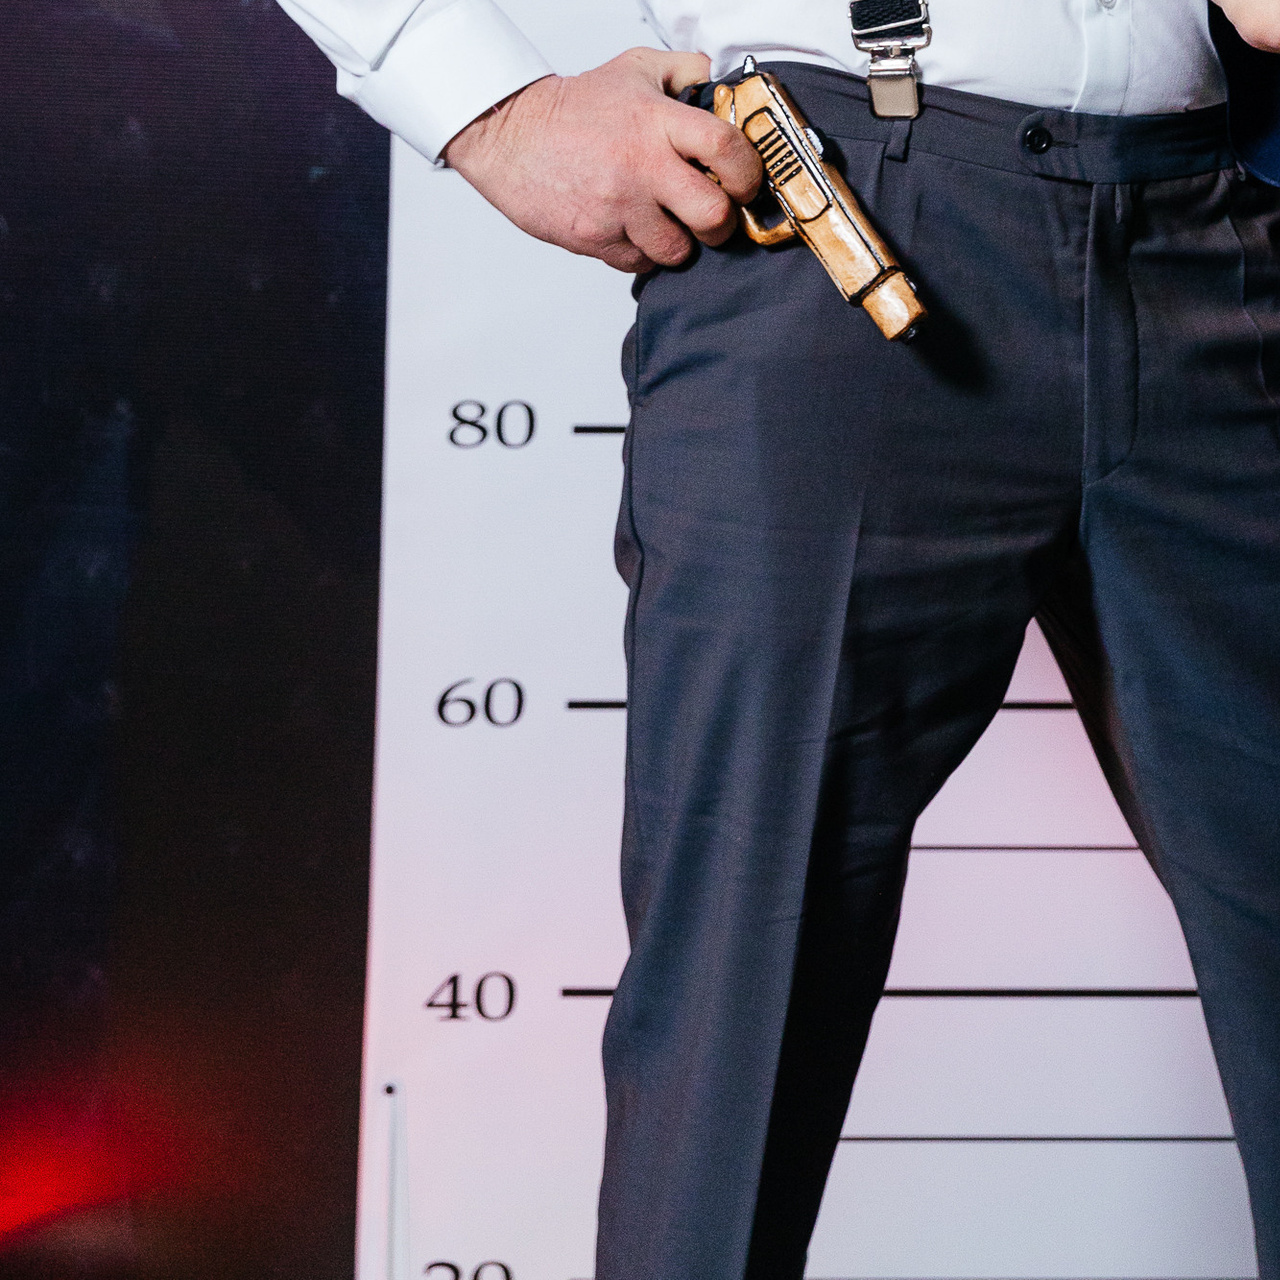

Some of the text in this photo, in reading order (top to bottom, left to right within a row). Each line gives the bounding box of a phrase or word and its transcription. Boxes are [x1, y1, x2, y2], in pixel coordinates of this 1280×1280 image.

[446, 399, 537, 450] 80
[436, 677, 525, 728] 60
[424, 971, 517, 1022] 40
